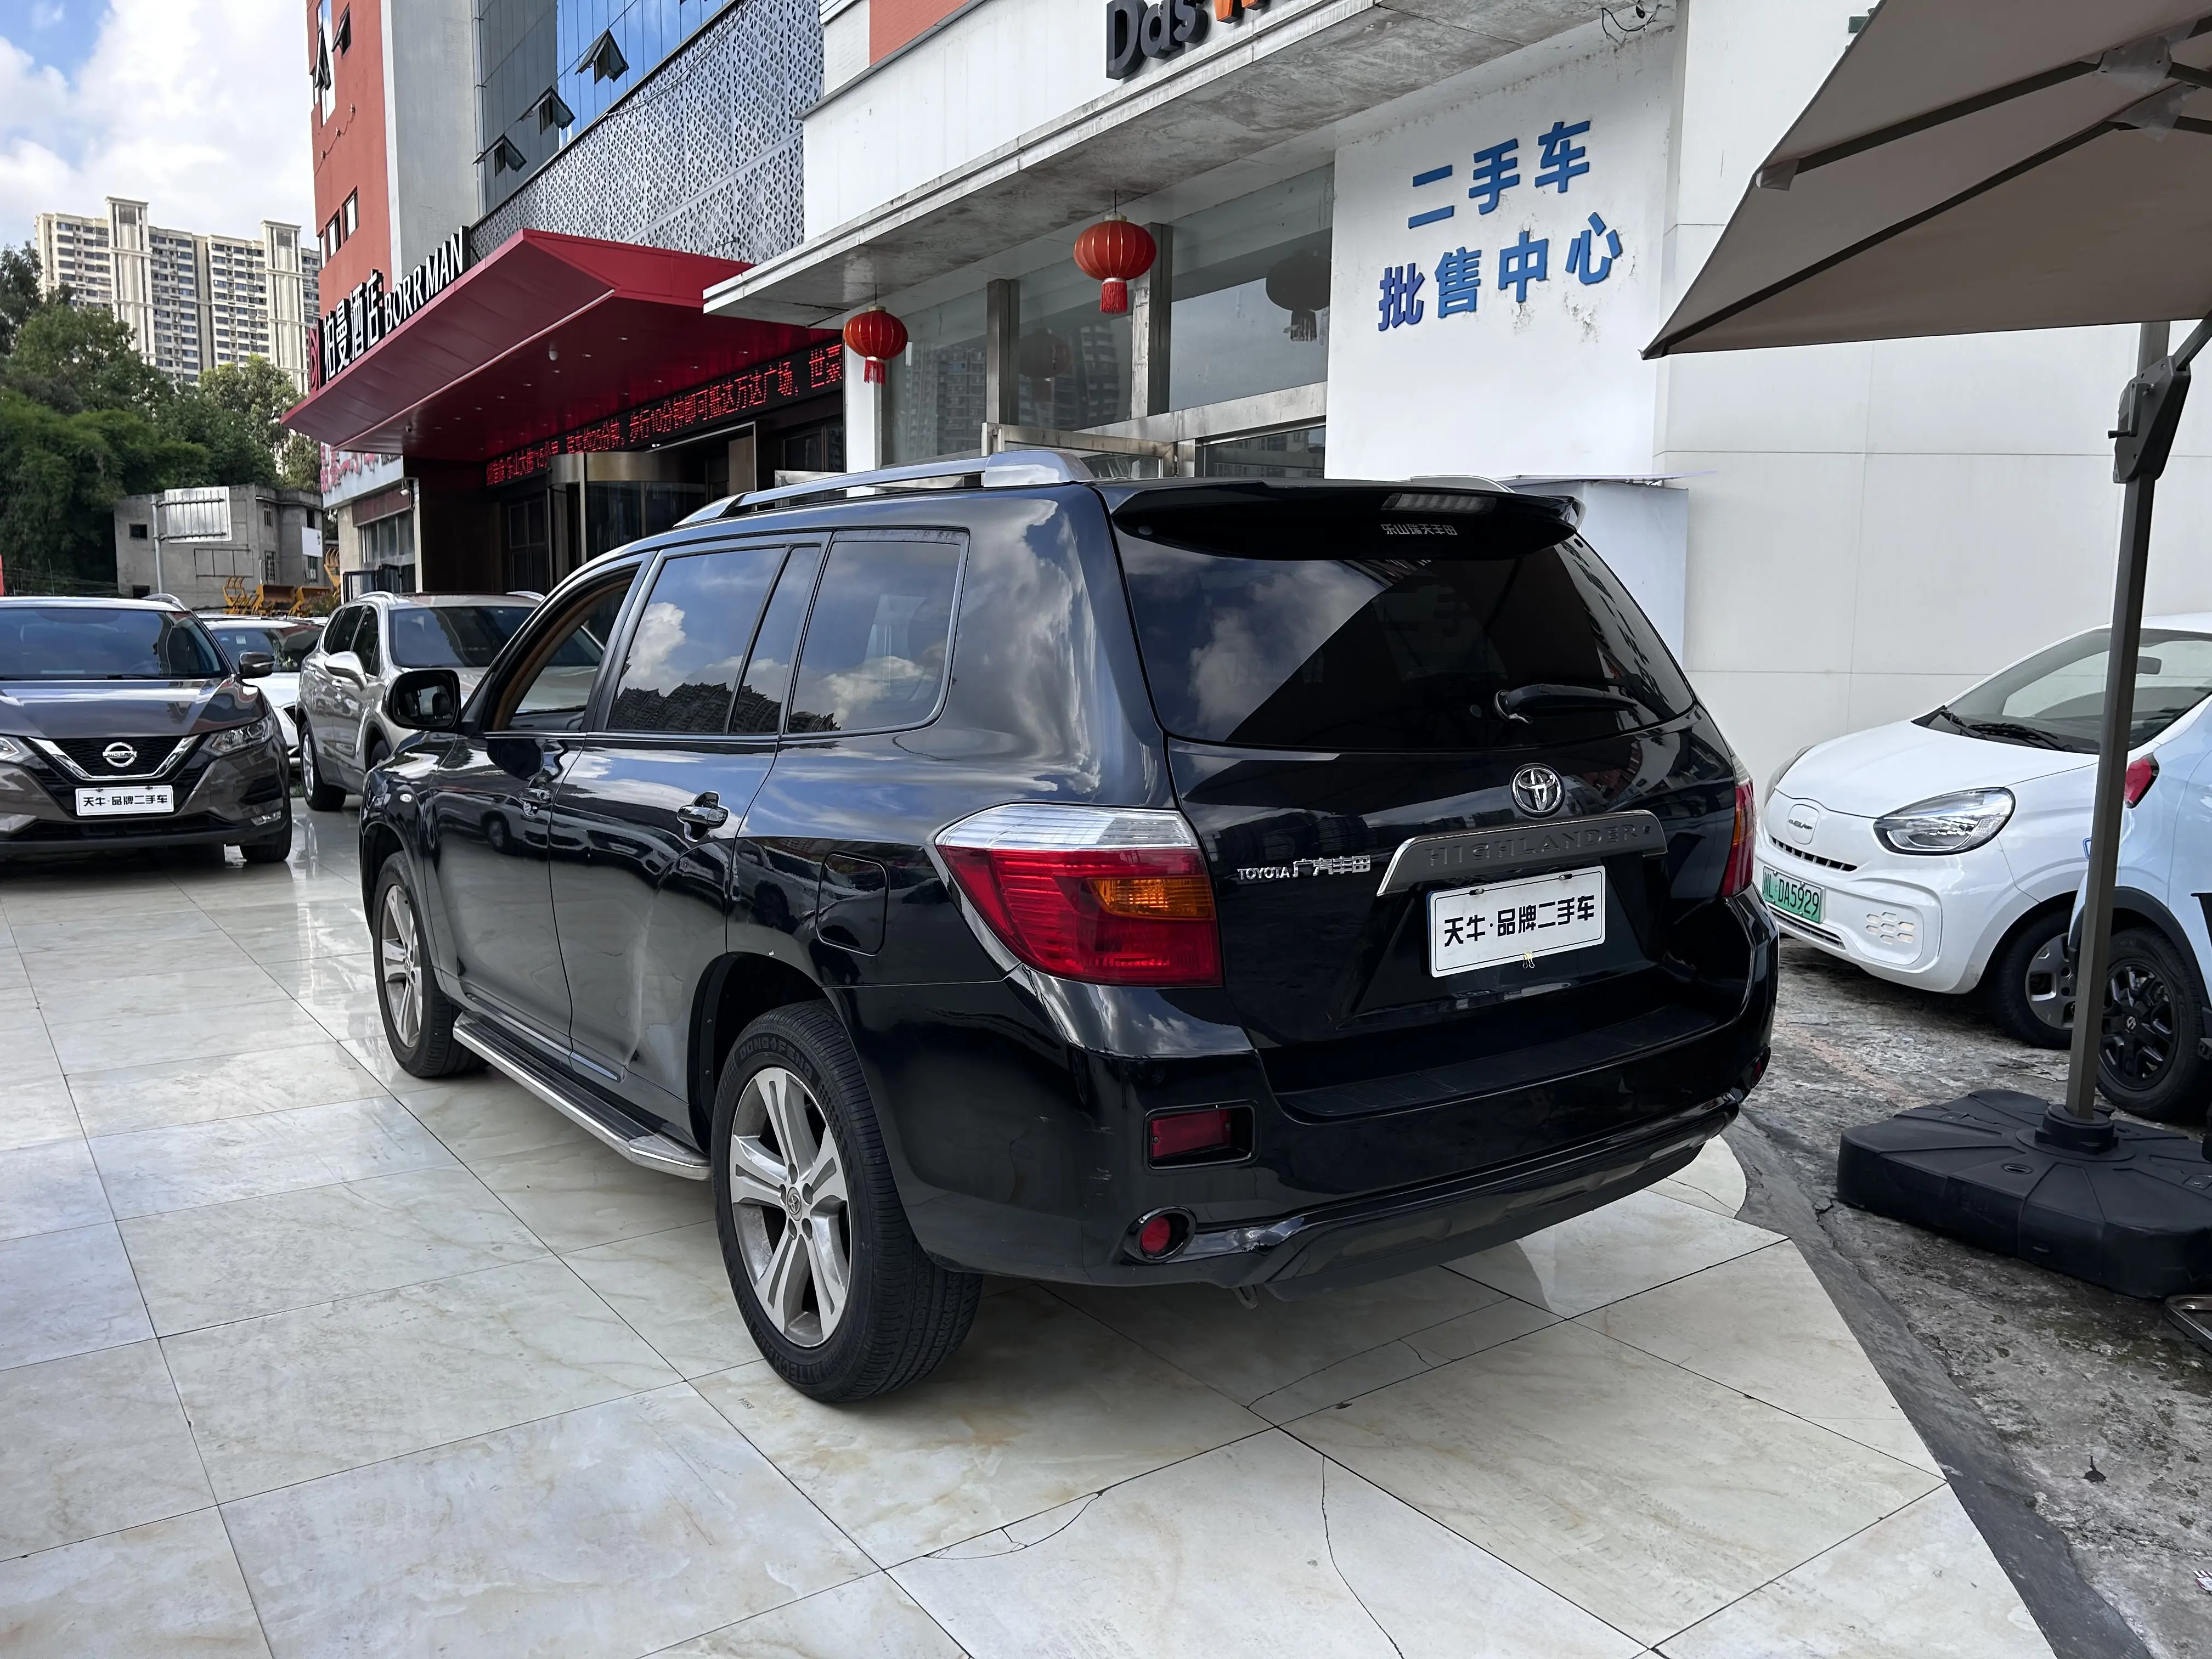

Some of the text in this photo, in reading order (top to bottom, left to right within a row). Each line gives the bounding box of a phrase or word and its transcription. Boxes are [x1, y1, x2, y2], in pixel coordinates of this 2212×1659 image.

[1106, 0, 1207, 80] Das
[1408, 121, 1590, 229] 二手车
[1378, 212, 1623, 331] 批售中心
[1380, 523, 1458, 535] 乐山瑞天丰田
[1237, 855, 1370, 880] TOYOTA 广汽丰田
[1426, 823, 1638, 867] HIGHLANDER
